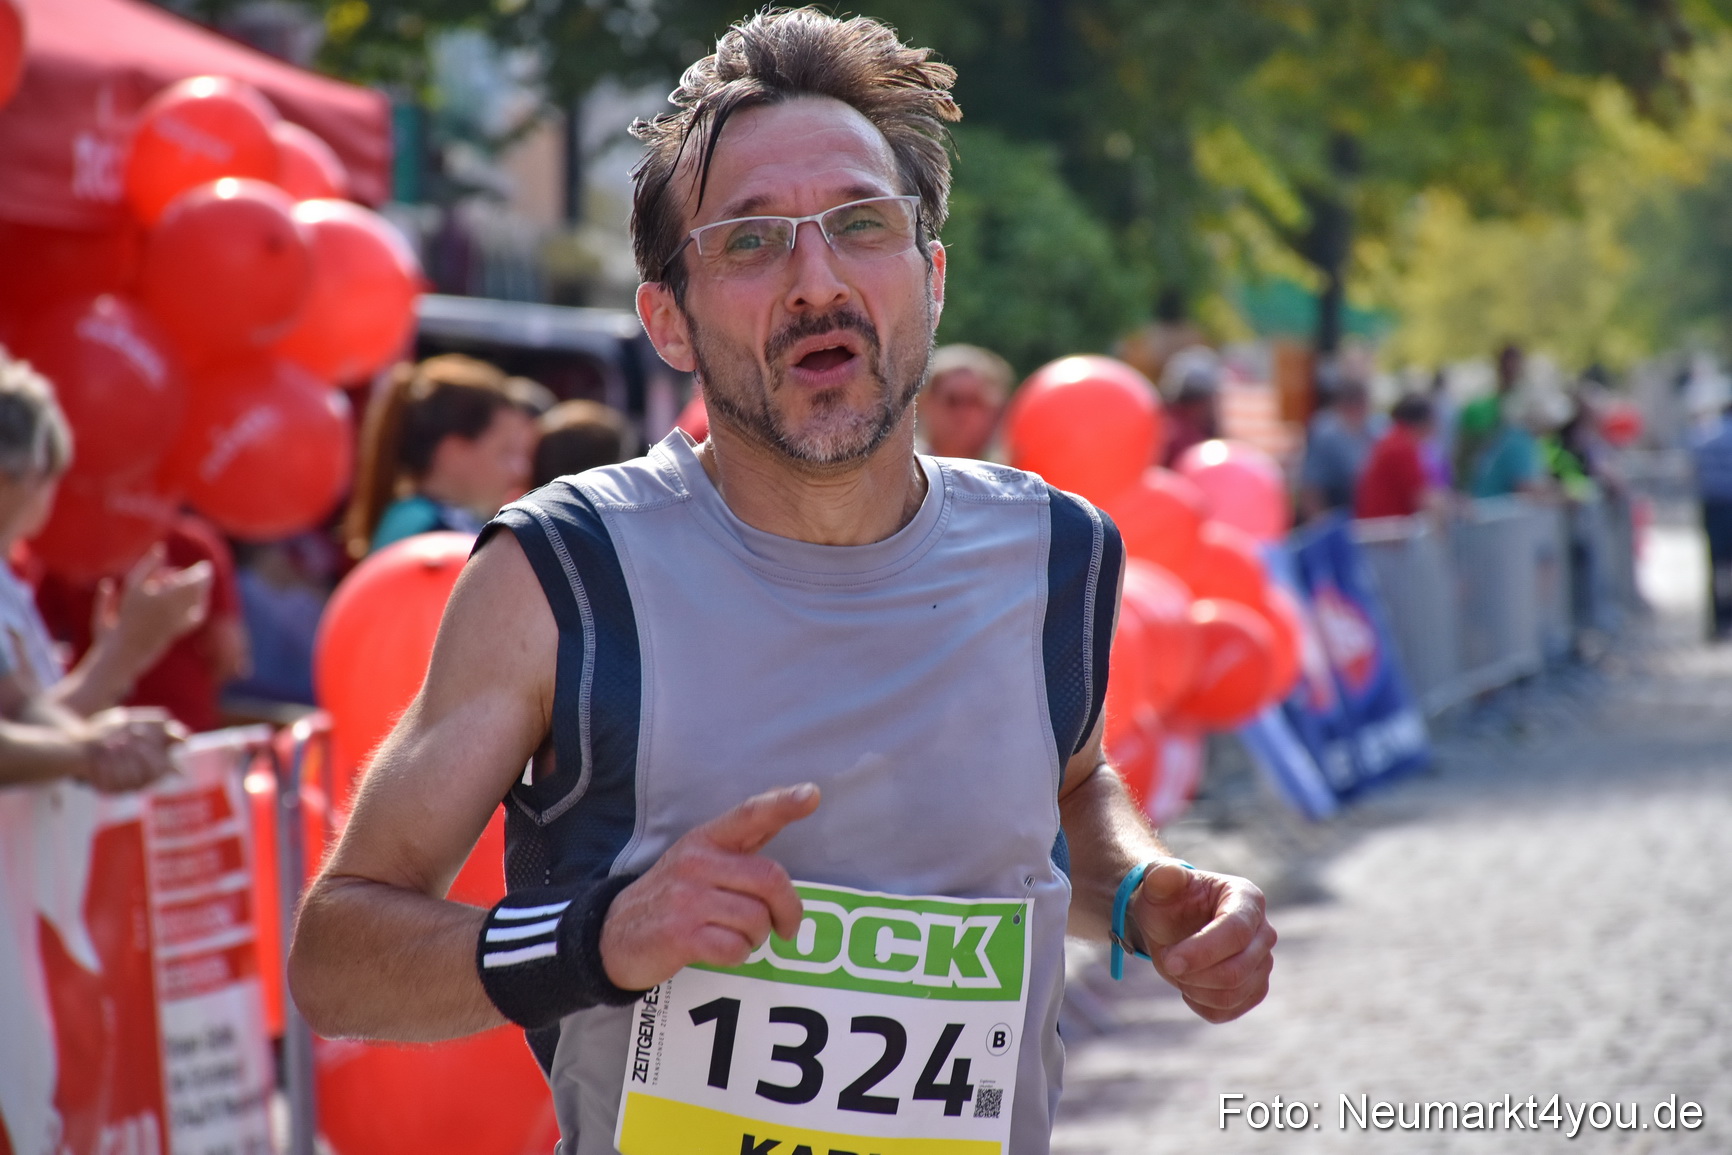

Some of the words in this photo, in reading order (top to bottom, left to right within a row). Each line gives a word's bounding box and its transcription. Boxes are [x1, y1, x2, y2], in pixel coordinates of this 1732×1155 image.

[744, 899, 1003, 989] OCK
[661, 975, 674, 1028] ZEITMESSUN
[688, 996, 975, 1117] 1324
[992, 1031, 1006, 1048] B
